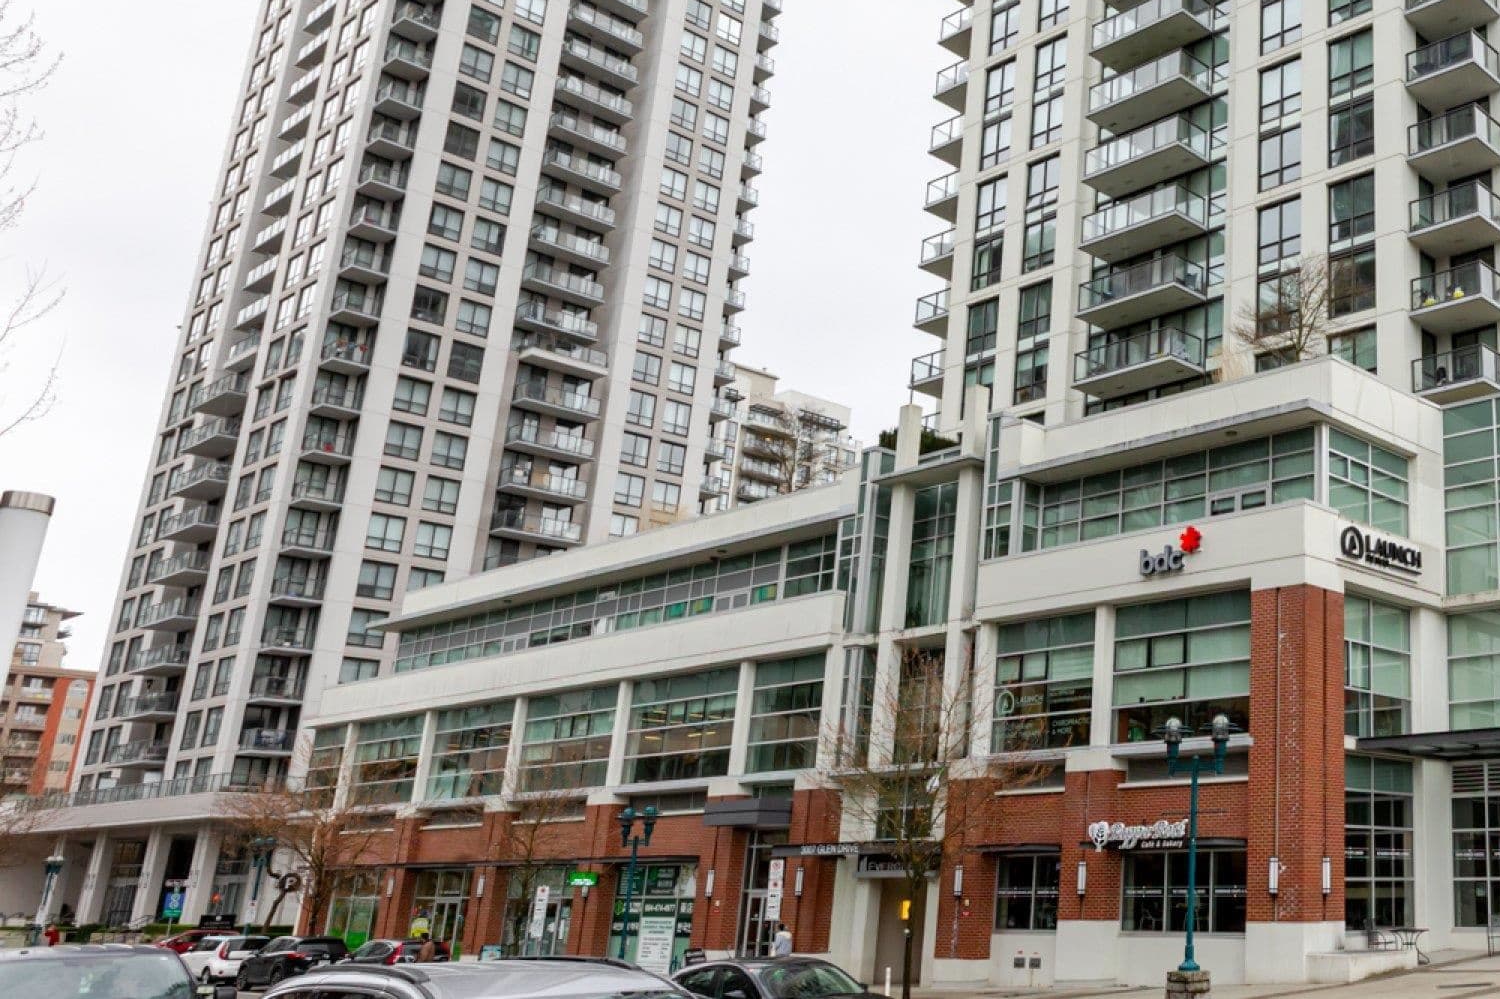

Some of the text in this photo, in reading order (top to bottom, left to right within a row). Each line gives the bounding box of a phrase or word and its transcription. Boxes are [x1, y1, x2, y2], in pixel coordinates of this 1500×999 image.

[1139, 545, 1185, 576] bdc
[1364, 534, 1422, 569] LAUNCH
[817, 845, 837, 855] GLEN
[837, 844, 859, 854] DRIVE
[285, 877, 297, 890] P
